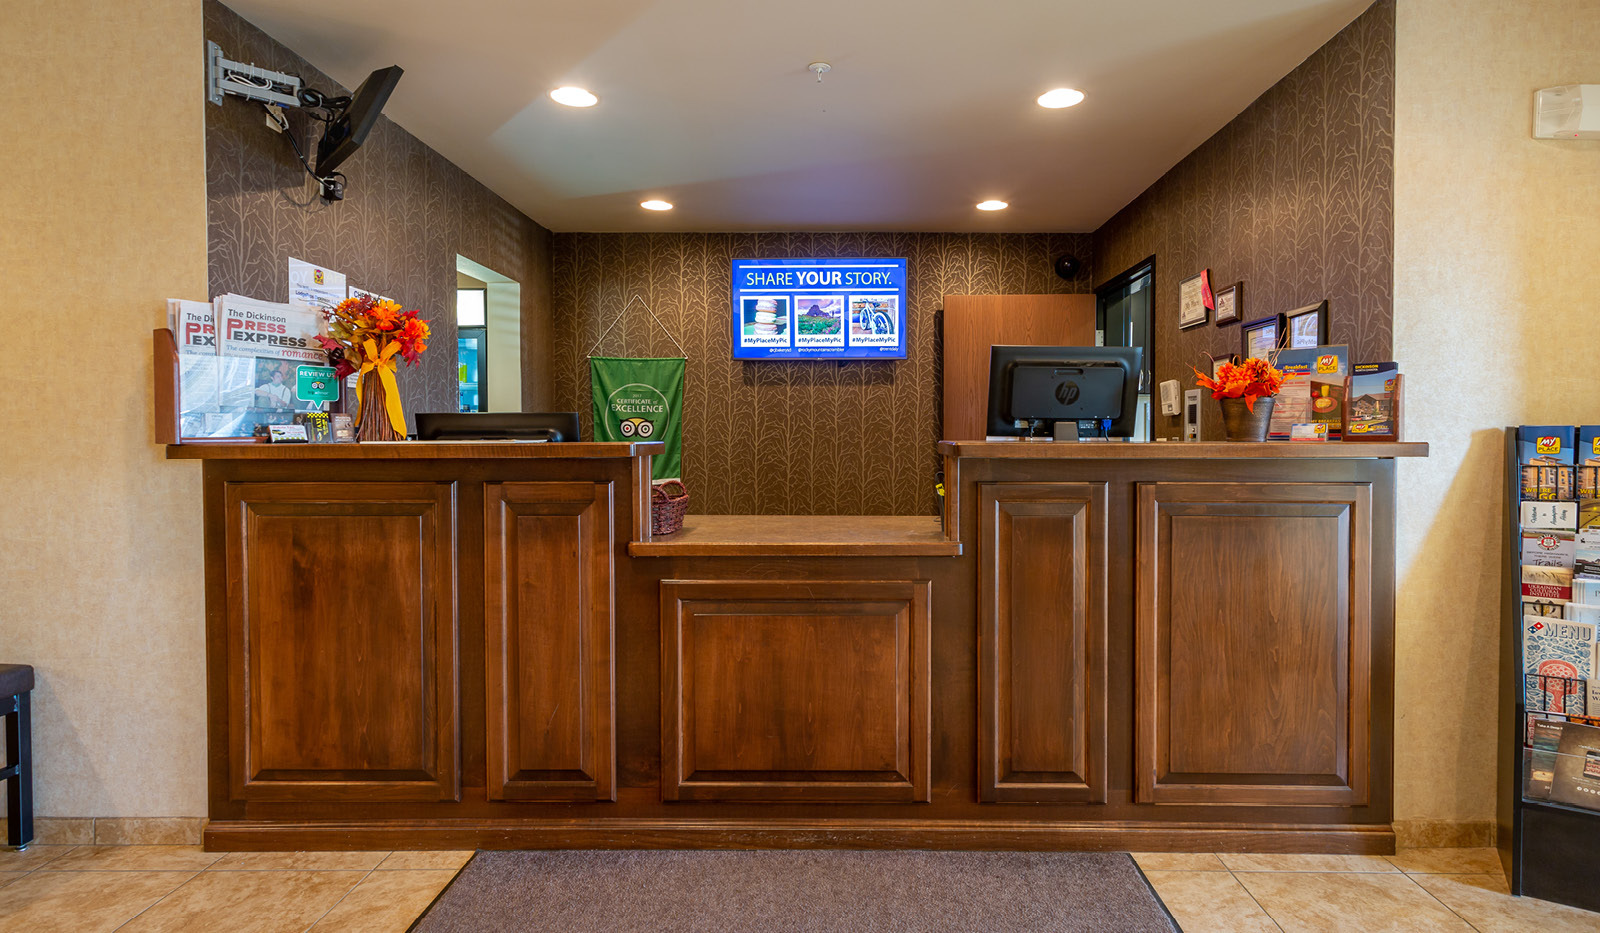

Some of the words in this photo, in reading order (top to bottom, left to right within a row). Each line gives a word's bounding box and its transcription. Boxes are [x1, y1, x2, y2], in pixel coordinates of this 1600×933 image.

[746, 272, 793, 286] SHARE
[796, 271, 842, 285] YOUR
[845, 271, 892, 285] STORY.
[186, 312, 202, 321] The
[227, 309, 244, 318] The
[246, 311, 286, 323] Dickinson
[226, 318, 287, 339] PRESS
[233, 331, 307, 347] EXPRESS
[797, 336, 842, 344] #MyPlaceMyPic
[238, 346, 274, 356] complexities
[281, 349, 323, 360] romance
[1320, 356, 1334, 365] MY
[611, 403, 664, 413] EXCELLENCE
[1540, 437, 1556, 446] MY
[1532, 559, 1563, 567] Trails
[1543, 623, 1591, 641] MENU
